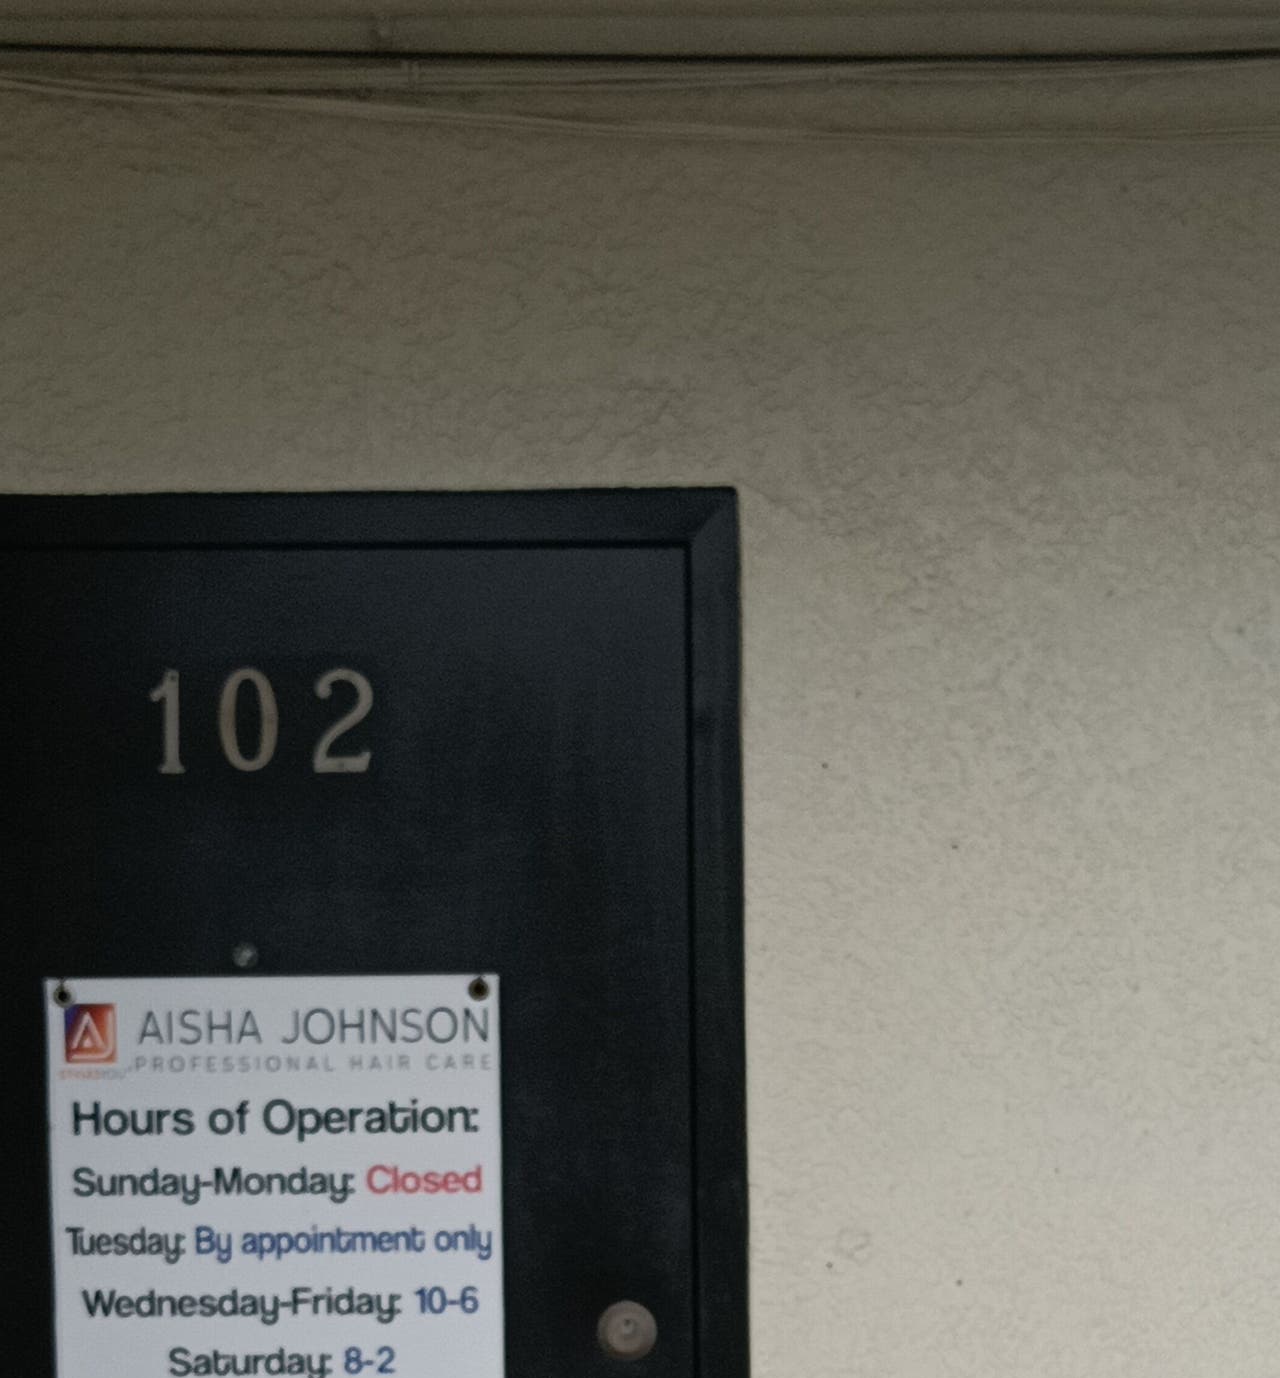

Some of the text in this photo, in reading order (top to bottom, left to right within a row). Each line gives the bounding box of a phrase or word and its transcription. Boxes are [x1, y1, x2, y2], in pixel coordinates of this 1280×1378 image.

[150, 668, 374, 774] 102
[138, 1006, 489, 1045] AISHA JOHNSON
[135, 1052, 492, 1073] PROFESSIONAL HAIR CARE
[72, 1098, 480, 1141] Hours of Operation:
[72, 1164, 483, 1204] Sunday-Monday: Closed
[65, 1225, 493, 1263] Tuesday: By appointment only
[82, 1286, 480, 1325] Wednesday-Friday: 10-6
[343, 1347, 397, 1375] 8-2
